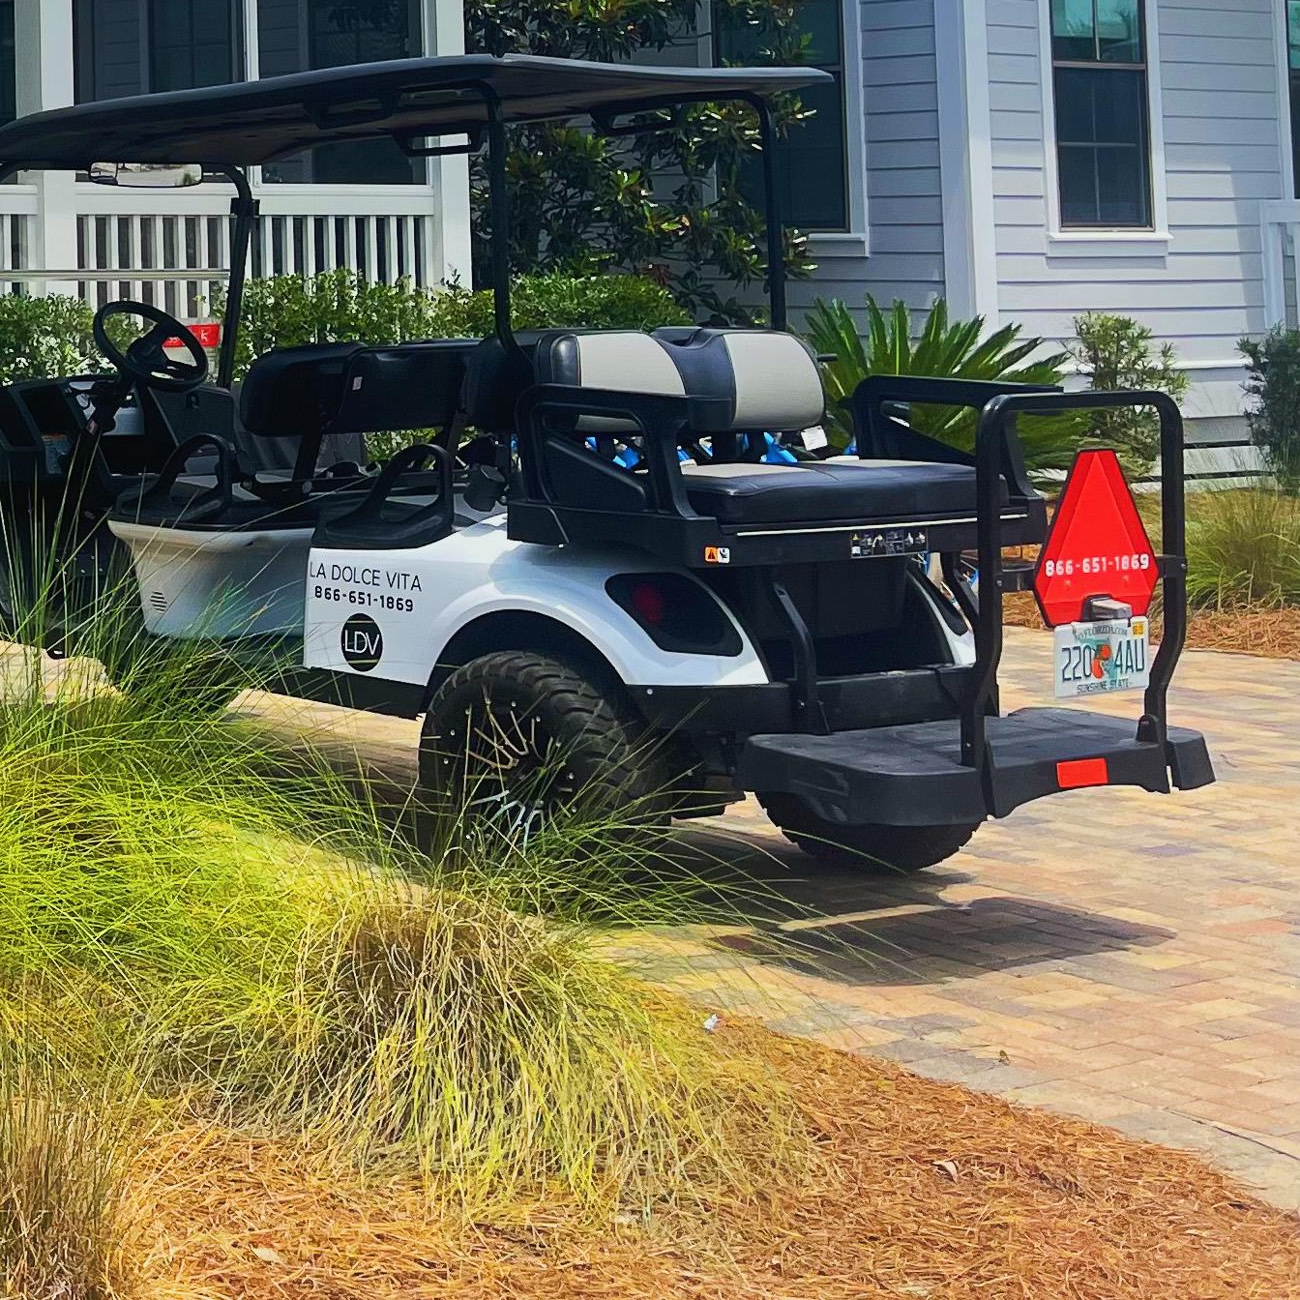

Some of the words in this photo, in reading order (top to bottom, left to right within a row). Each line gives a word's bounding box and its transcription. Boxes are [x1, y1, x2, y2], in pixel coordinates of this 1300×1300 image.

[309, 561, 326, 579] LA
[331, 564, 381, 587] DOLCE
[386, 571, 422, 592] VITA
[1045, 553, 1149, 577] 866-651-1869
[314, 585, 414, 612] 866-651-1869
[344, 629, 380, 656] LDV
